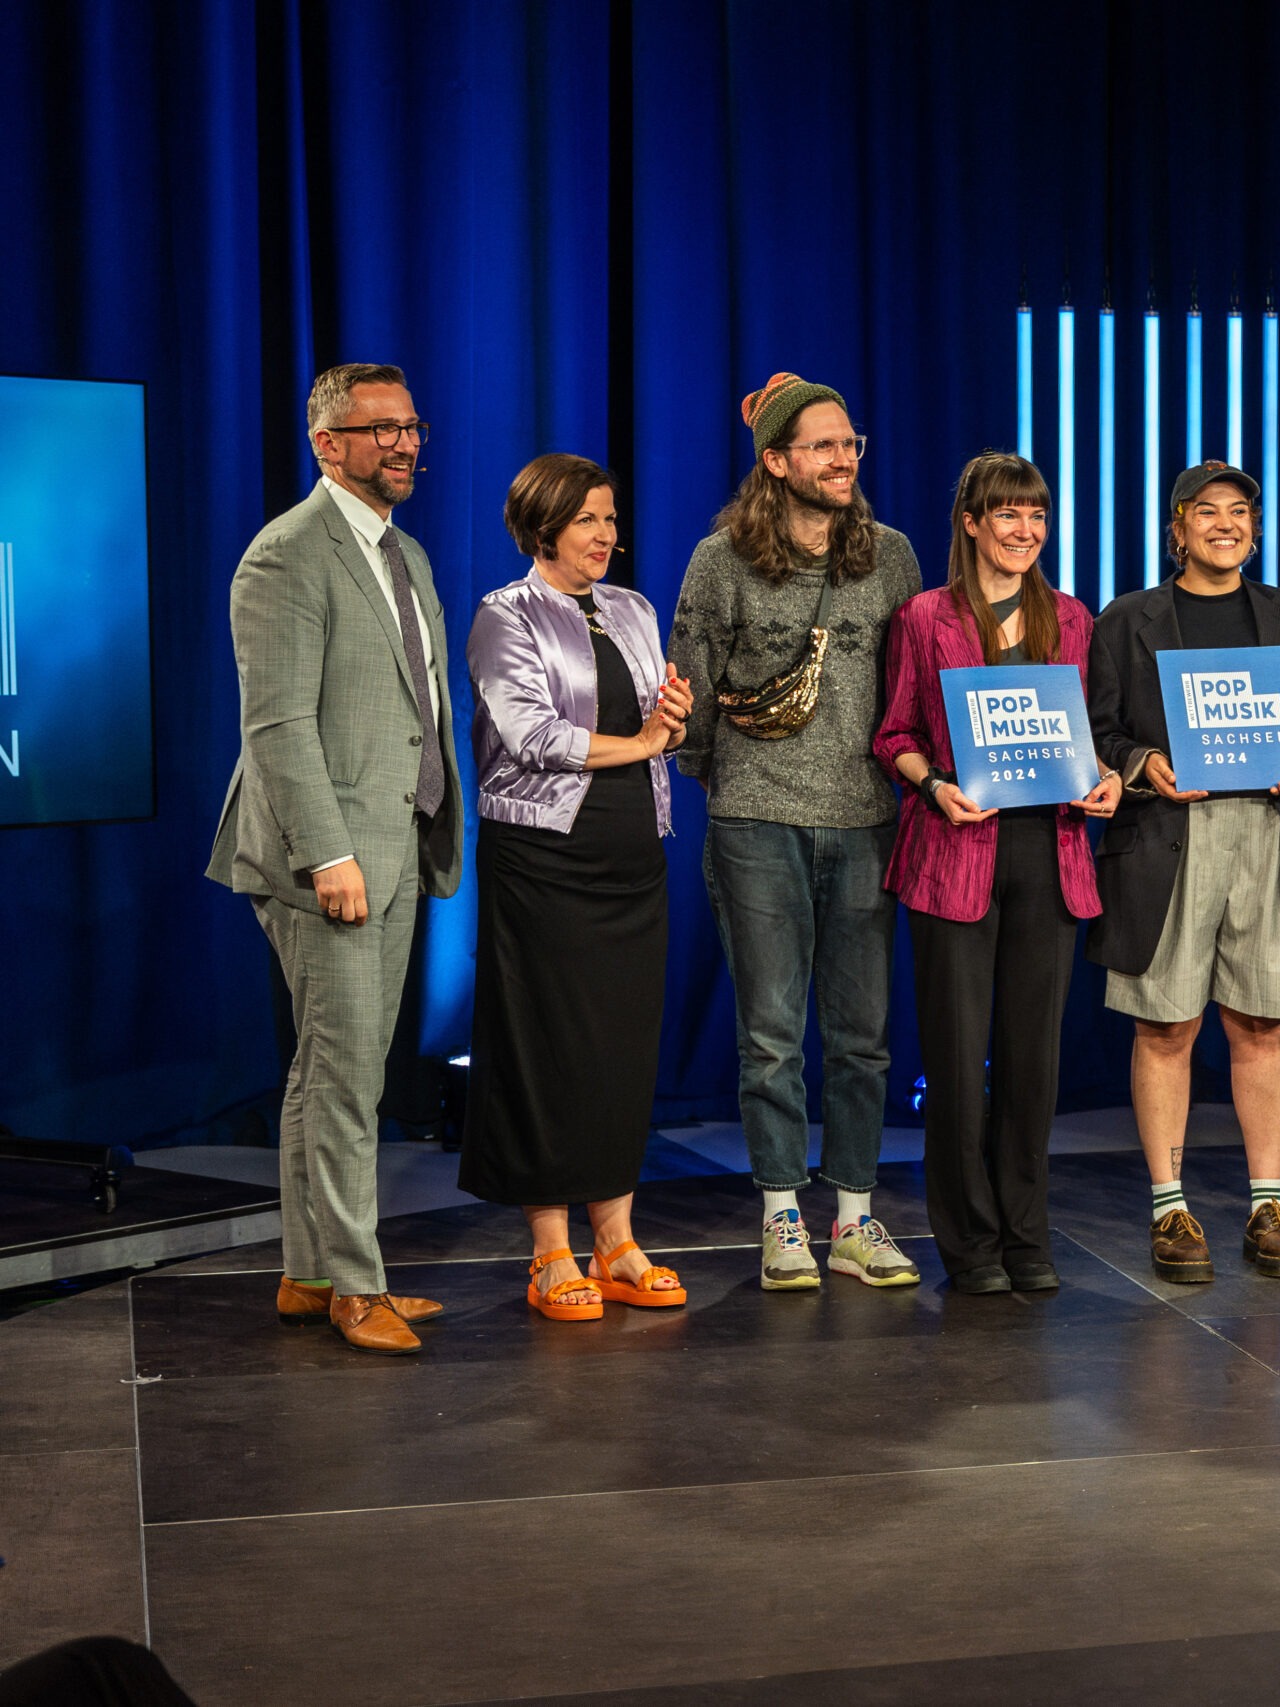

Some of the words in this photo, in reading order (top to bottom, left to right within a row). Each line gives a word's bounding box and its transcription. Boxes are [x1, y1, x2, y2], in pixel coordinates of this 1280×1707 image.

[1200, 679, 1247, 697] POP
[985, 695, 1033, 714] POP
[1203, 700, 1277, 721] MUSIK
[990, 718, 1064, 738] MUSIK
[988, 747, 1076, 763] SACHSEN
[1204, 752, 1247, 765] 2024
[991, 767, 1037, 782] 2024
